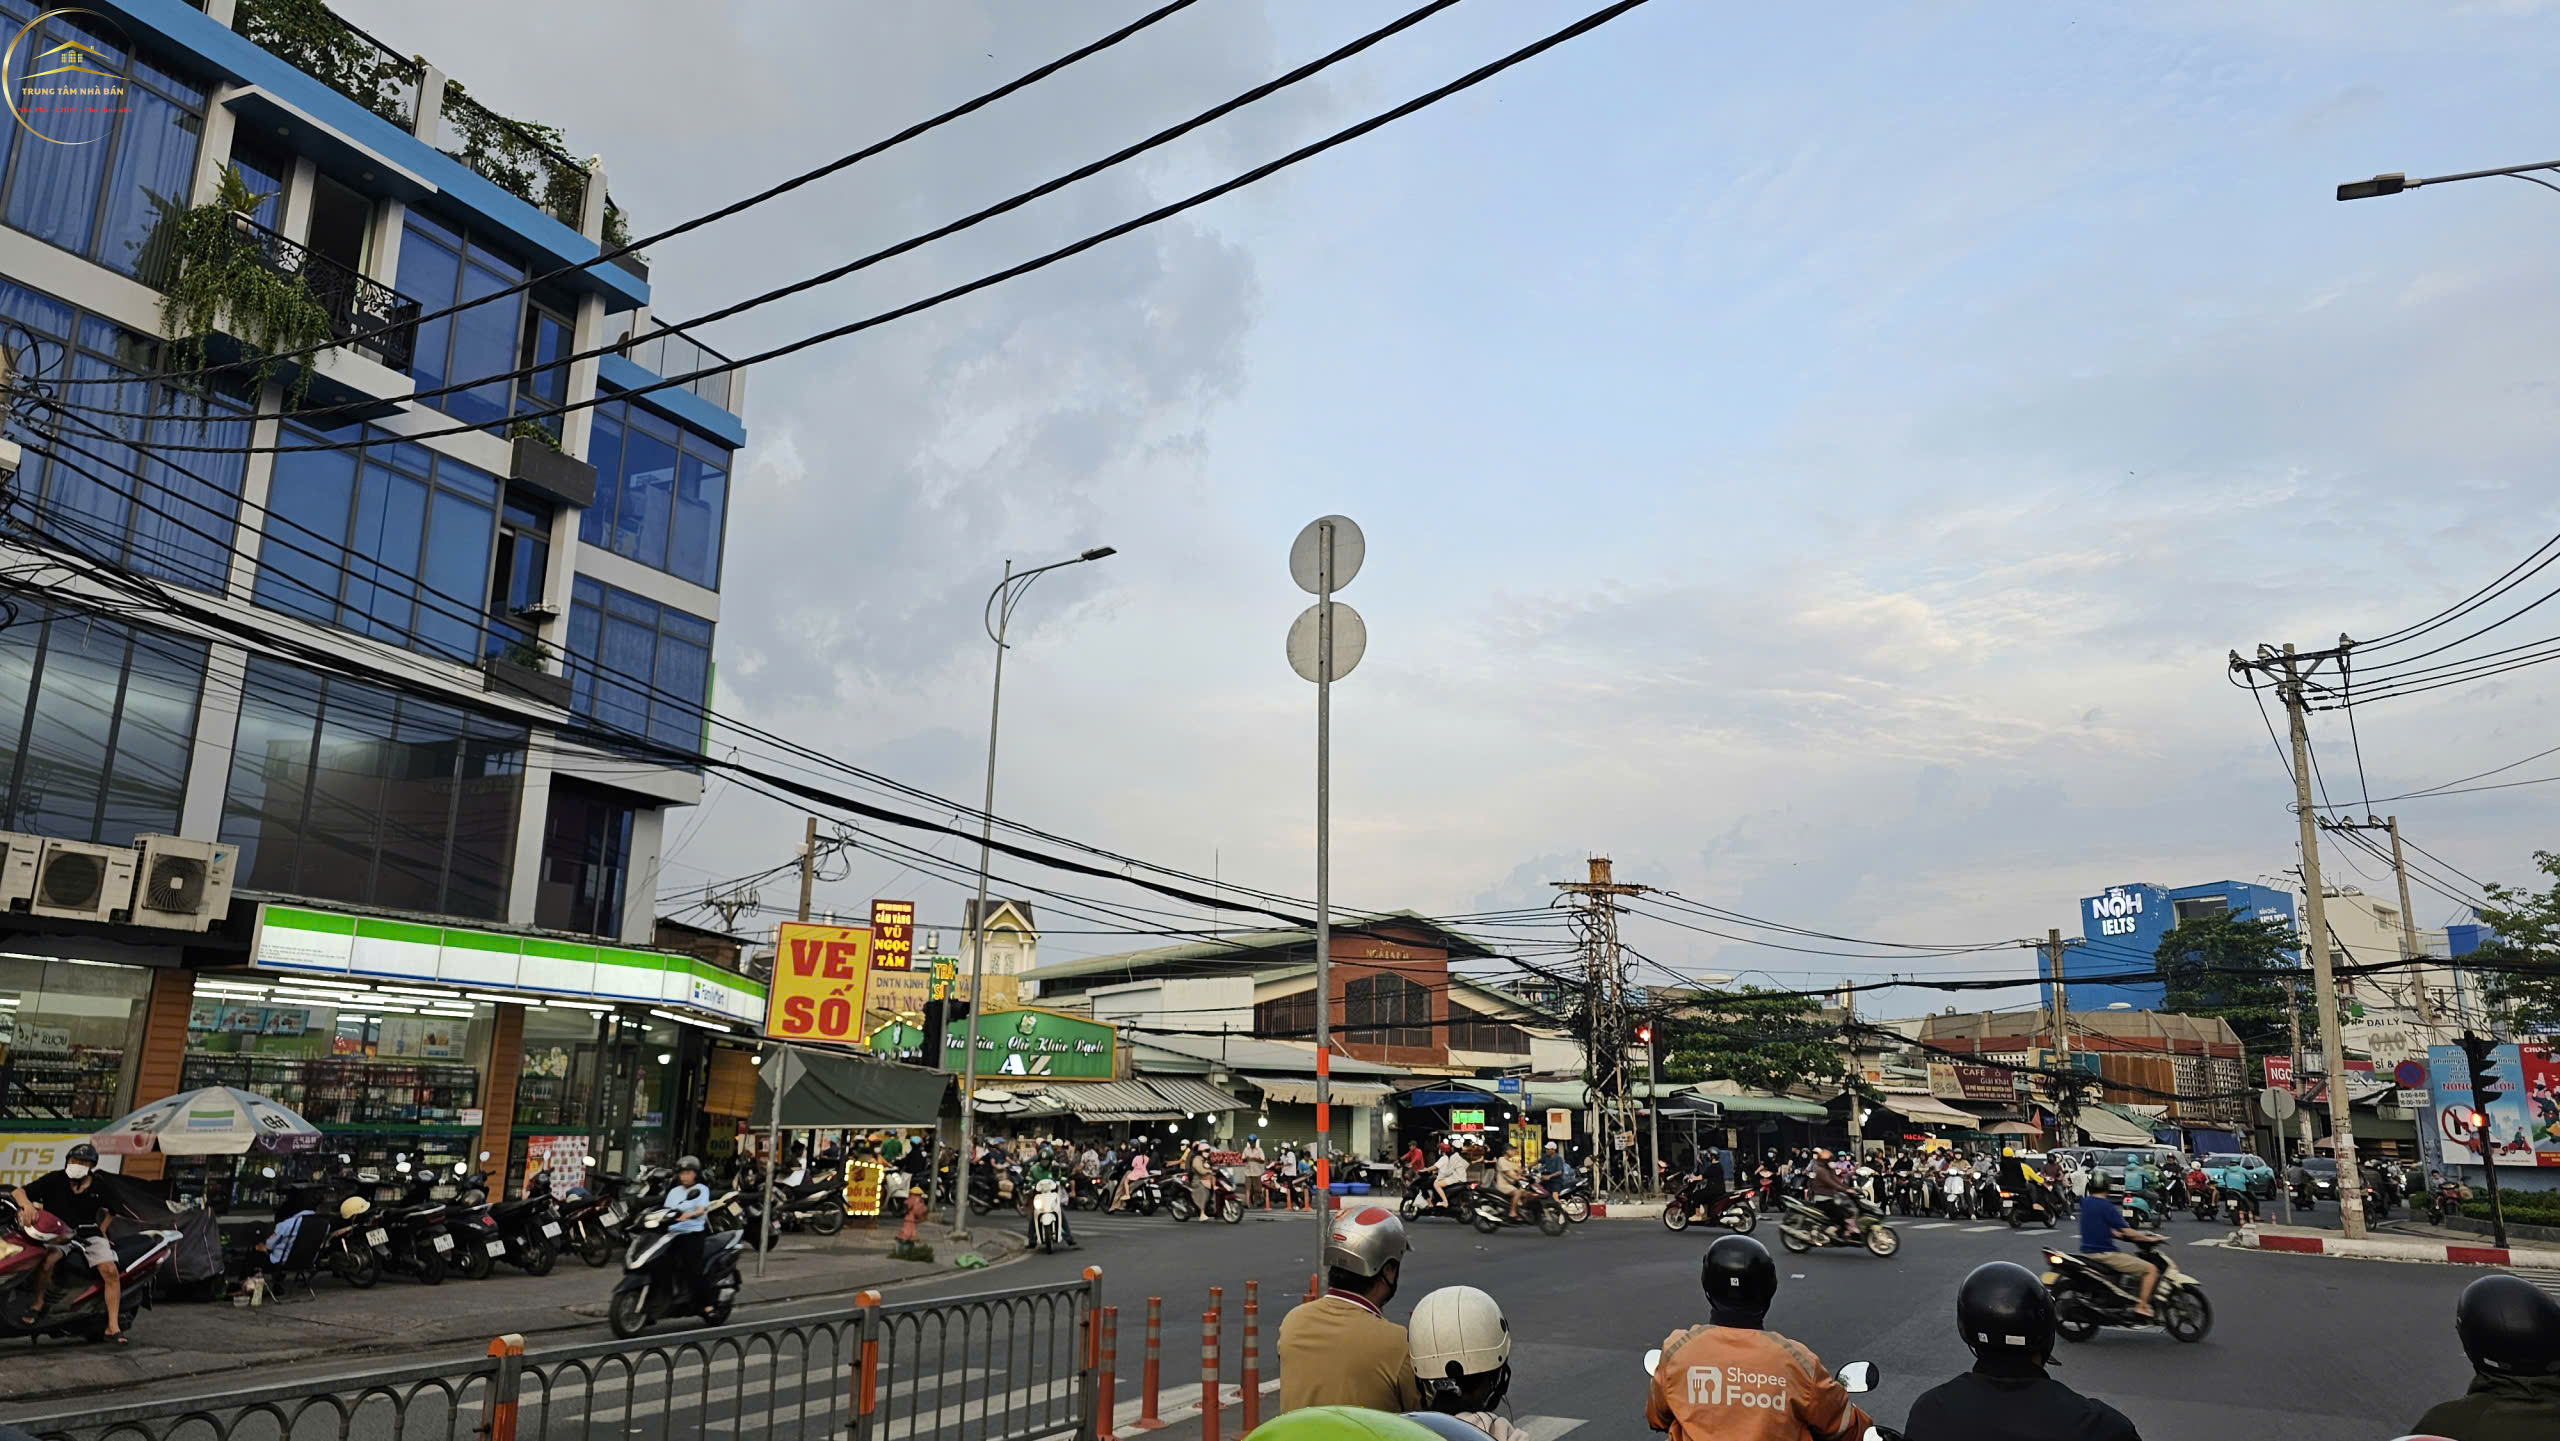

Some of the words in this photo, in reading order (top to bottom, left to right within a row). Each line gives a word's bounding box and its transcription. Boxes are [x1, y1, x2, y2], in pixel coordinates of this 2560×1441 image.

[883, 926, 902, 938] VŨ
[2102, 916, 2136, 936] IELTS
[790, 931, 857, 980] VÉ
[874, 939, 910, 953] NGỌC
[877, 953, 905, 967] TÂM
[876, 977, 901, 988] DNTN
[903, 978, 924, 989] KINH
[782, 984, 856, 1036] SỐ
[1007, 1036, 1030, 1051] Chè
[1035, 1037, 1069, 1052] Khúc
[1073, 1039, 1104, 1057] Bạch
[997, 1053, 1053, 1076] AZ
[11, 1147, 55, 1166] IT'S
[1726, 1367, 1787, 1389] Shopee
[1726, 1385, 1787, 1411] Food
